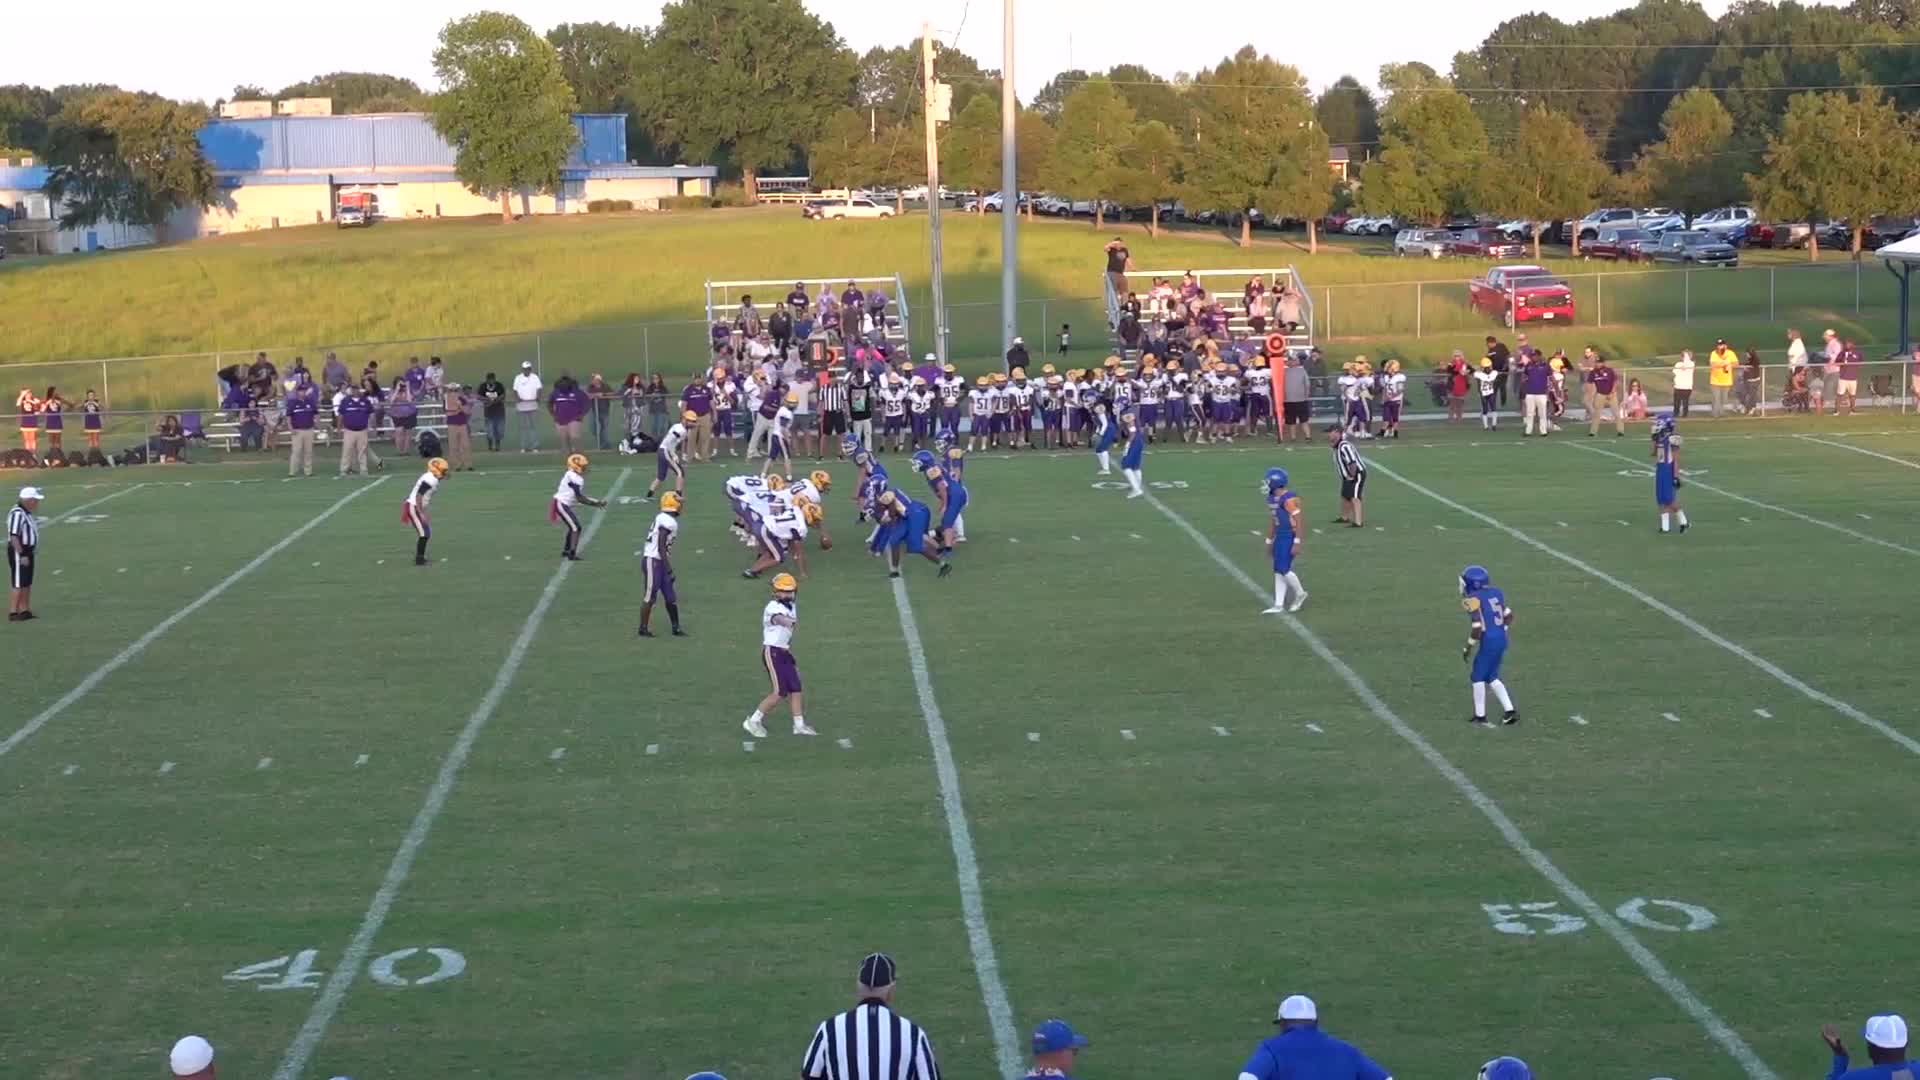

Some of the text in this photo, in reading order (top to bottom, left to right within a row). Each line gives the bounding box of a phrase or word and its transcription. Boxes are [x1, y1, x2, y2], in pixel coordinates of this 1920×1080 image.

[1487, 596, 1504, 626] 5
[1480, 896, 1719, 935] 50
[221, 947, 467, 992] 40
